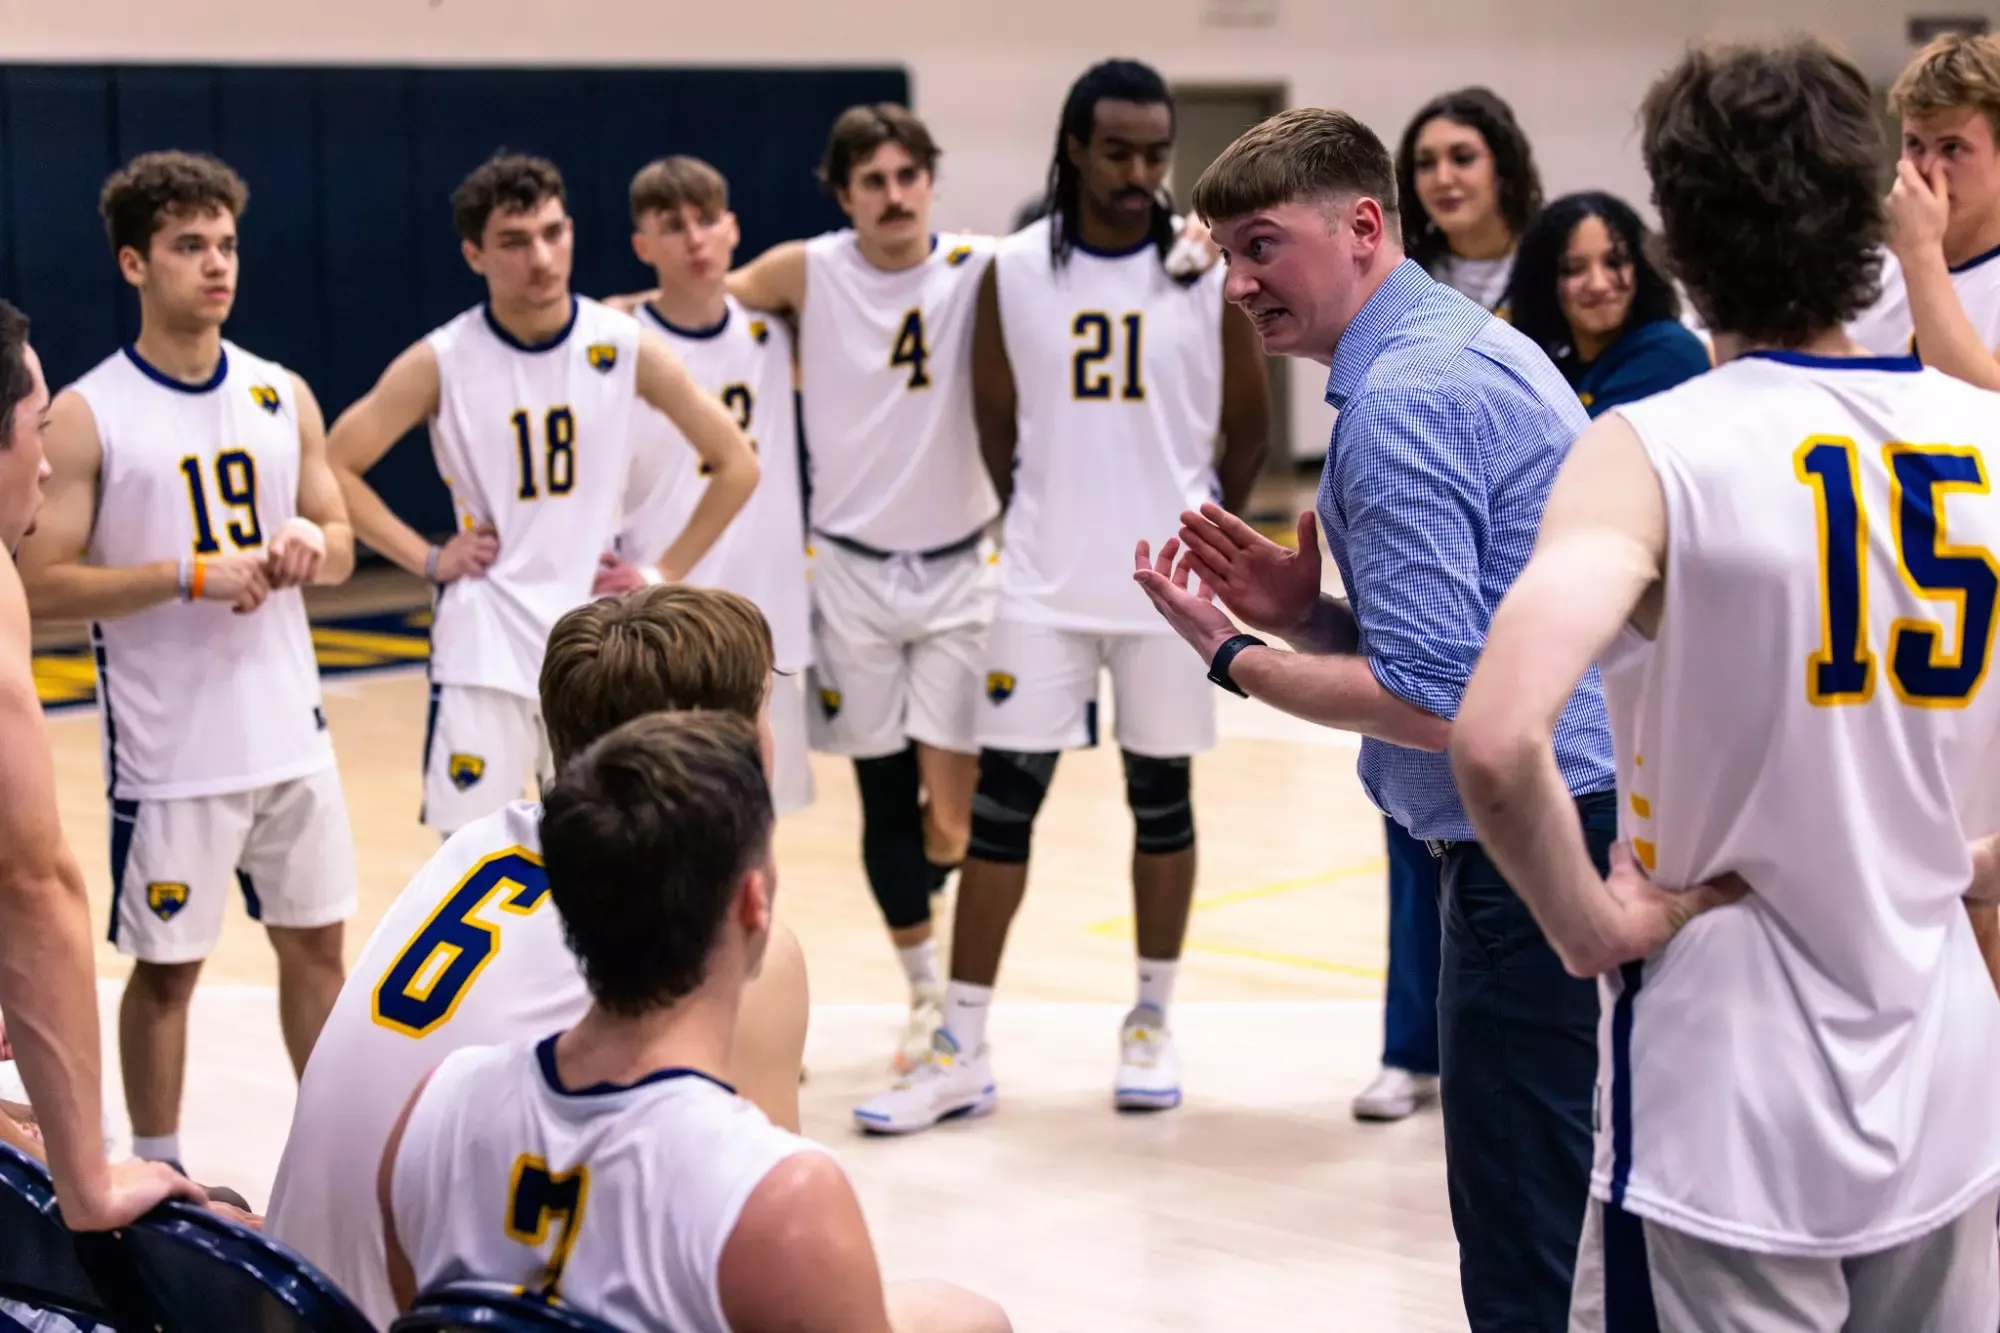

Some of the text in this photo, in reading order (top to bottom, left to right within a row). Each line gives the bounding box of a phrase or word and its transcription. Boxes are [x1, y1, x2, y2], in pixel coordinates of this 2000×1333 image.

[890, 309, 931, 391] 4
[1072, 311, 1146, 402] 21
[180, 448, 263, 555] 19
[511, 405, 576, 501] 18
[1793, 433, 2000, 709] 15
[371, 845, 552, 1039] 6
[504, 1152, 590, 1306] 7
